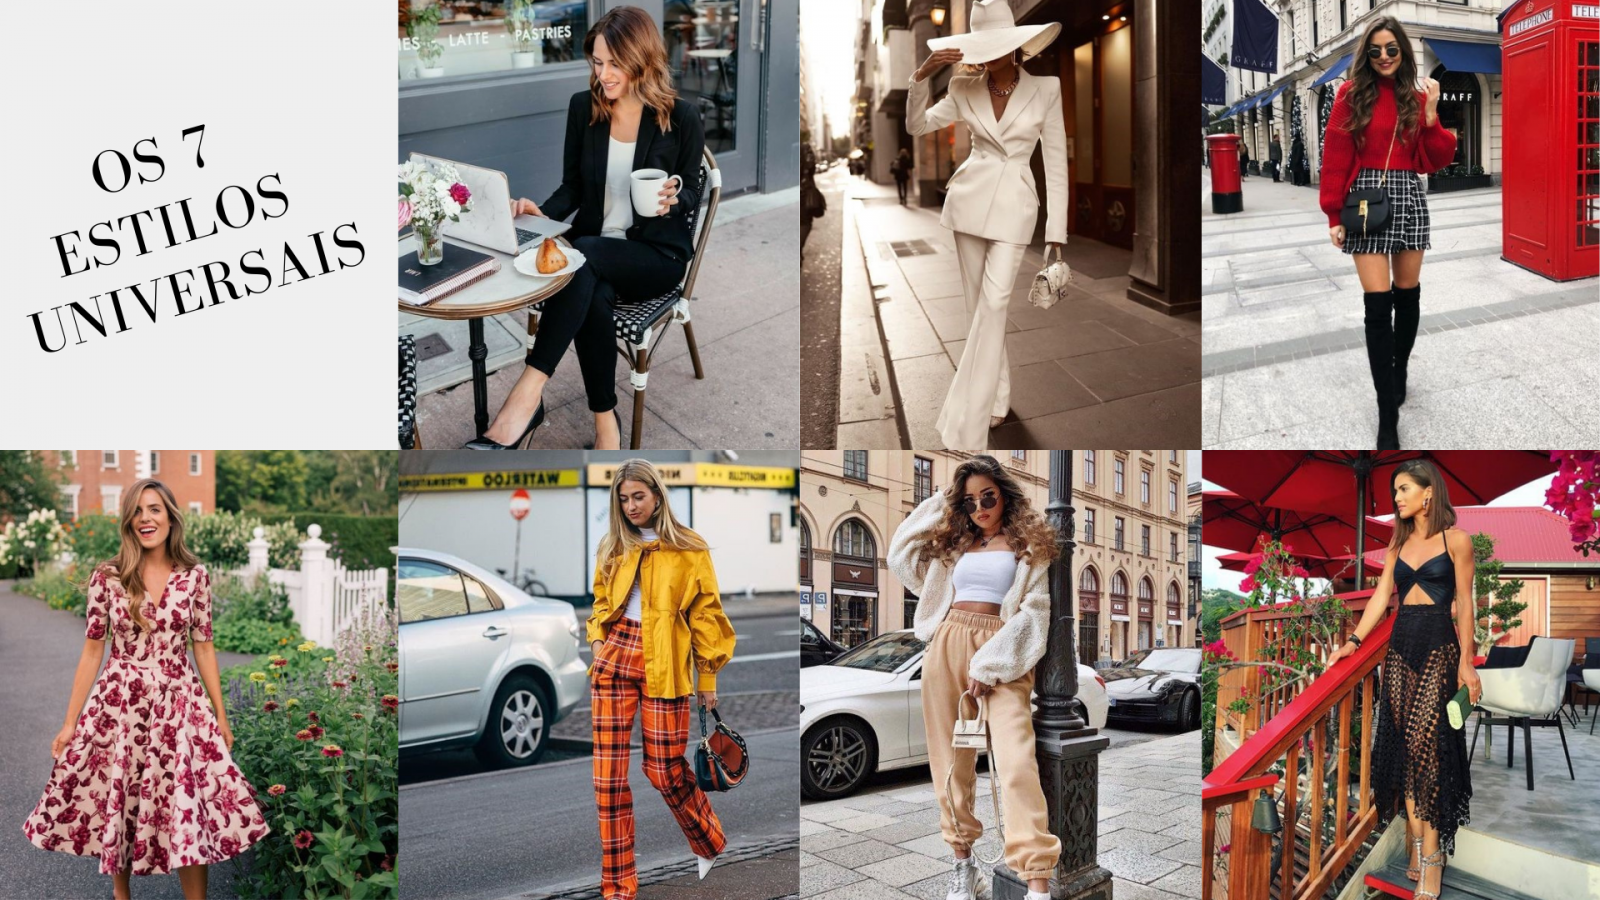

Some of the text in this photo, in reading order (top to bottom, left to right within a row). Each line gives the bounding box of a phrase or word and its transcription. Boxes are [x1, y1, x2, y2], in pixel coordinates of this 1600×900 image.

[1511, 9, 1552, 34] TELEPHONE
[449, 32, 489, 47] LATTE
[515, 26, 572, 41] PASTRIES
[1235, 55, 1273, 68] GRAFF
[1437, 92, 1473, 102] RAFF
